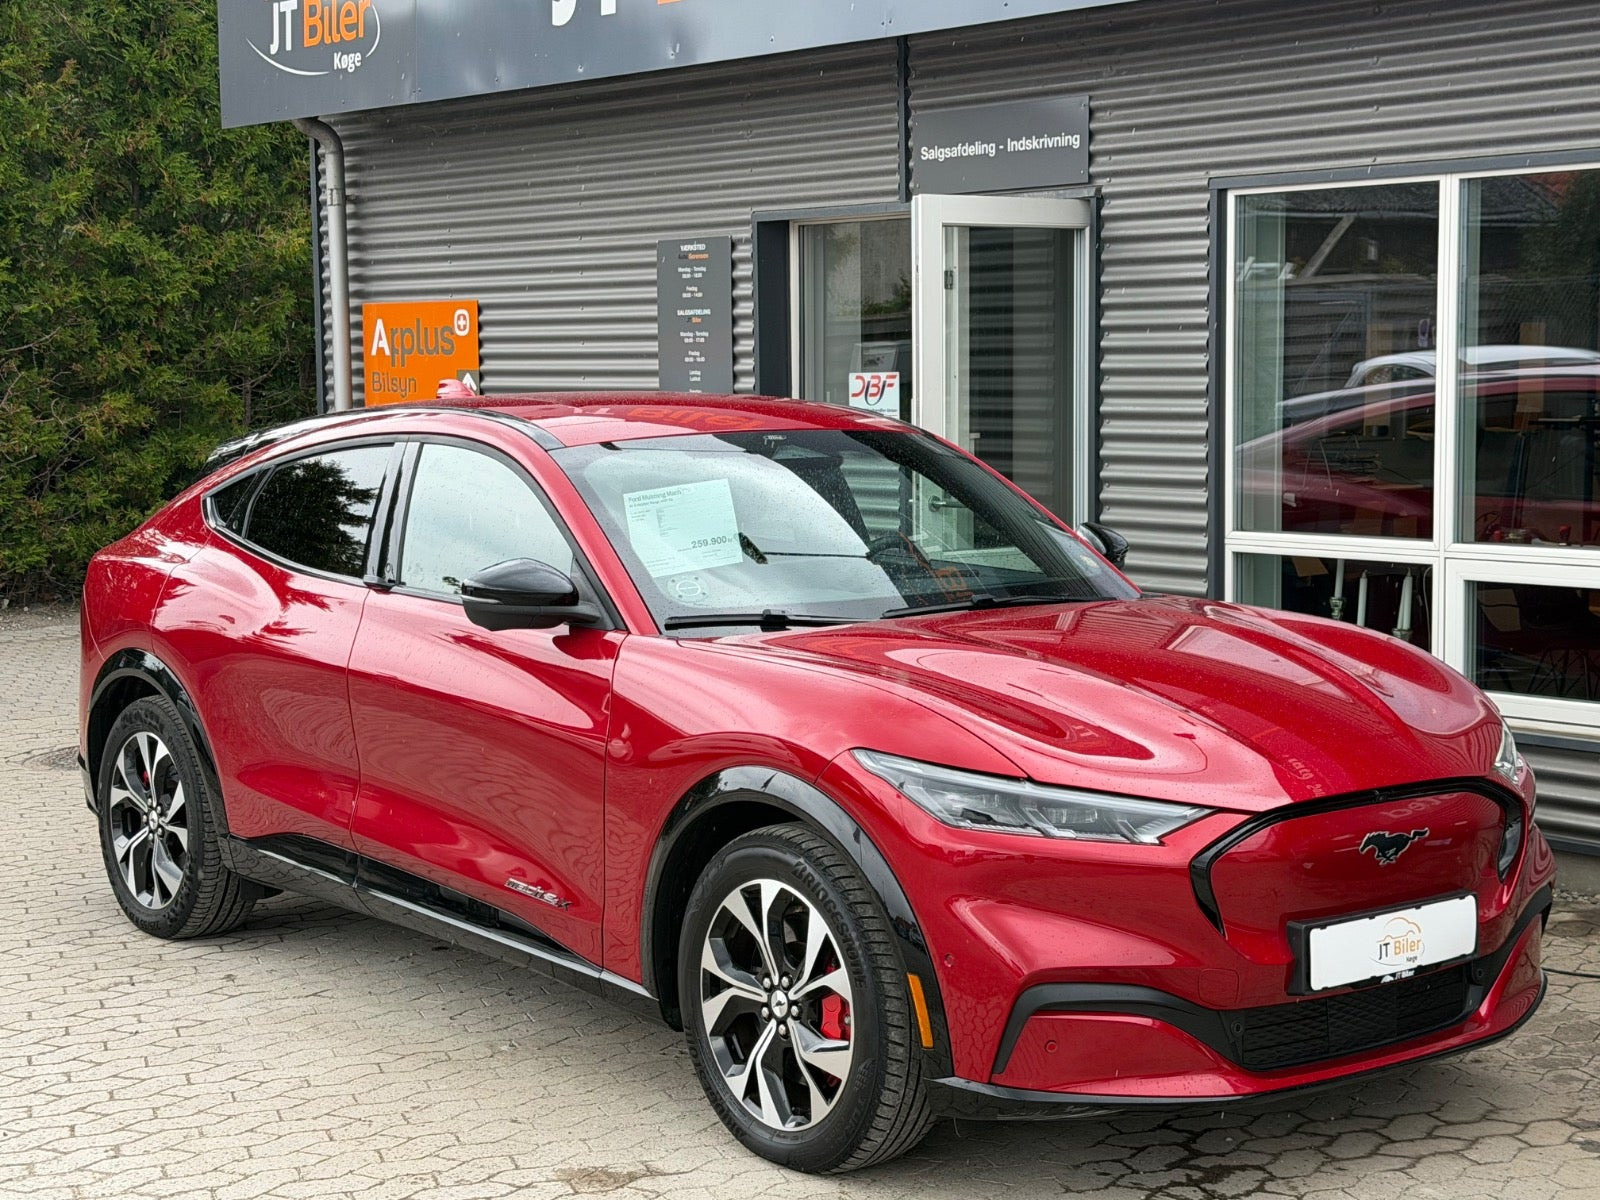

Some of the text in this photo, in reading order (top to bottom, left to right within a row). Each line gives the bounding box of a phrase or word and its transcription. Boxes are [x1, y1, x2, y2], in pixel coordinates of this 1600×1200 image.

[270, 0, 371, 55] JT Biler
[333, 51, 362, 73] Køge
[920, 141, 996, 162] Salgsafdeling
[1007, 132, 1081, 152] Indskrivning
[372, 371, 417, 398] Bilsyn
[691, 536, 727, 549] 259.900
[1378, 938, 1421, 960] JT Biler
